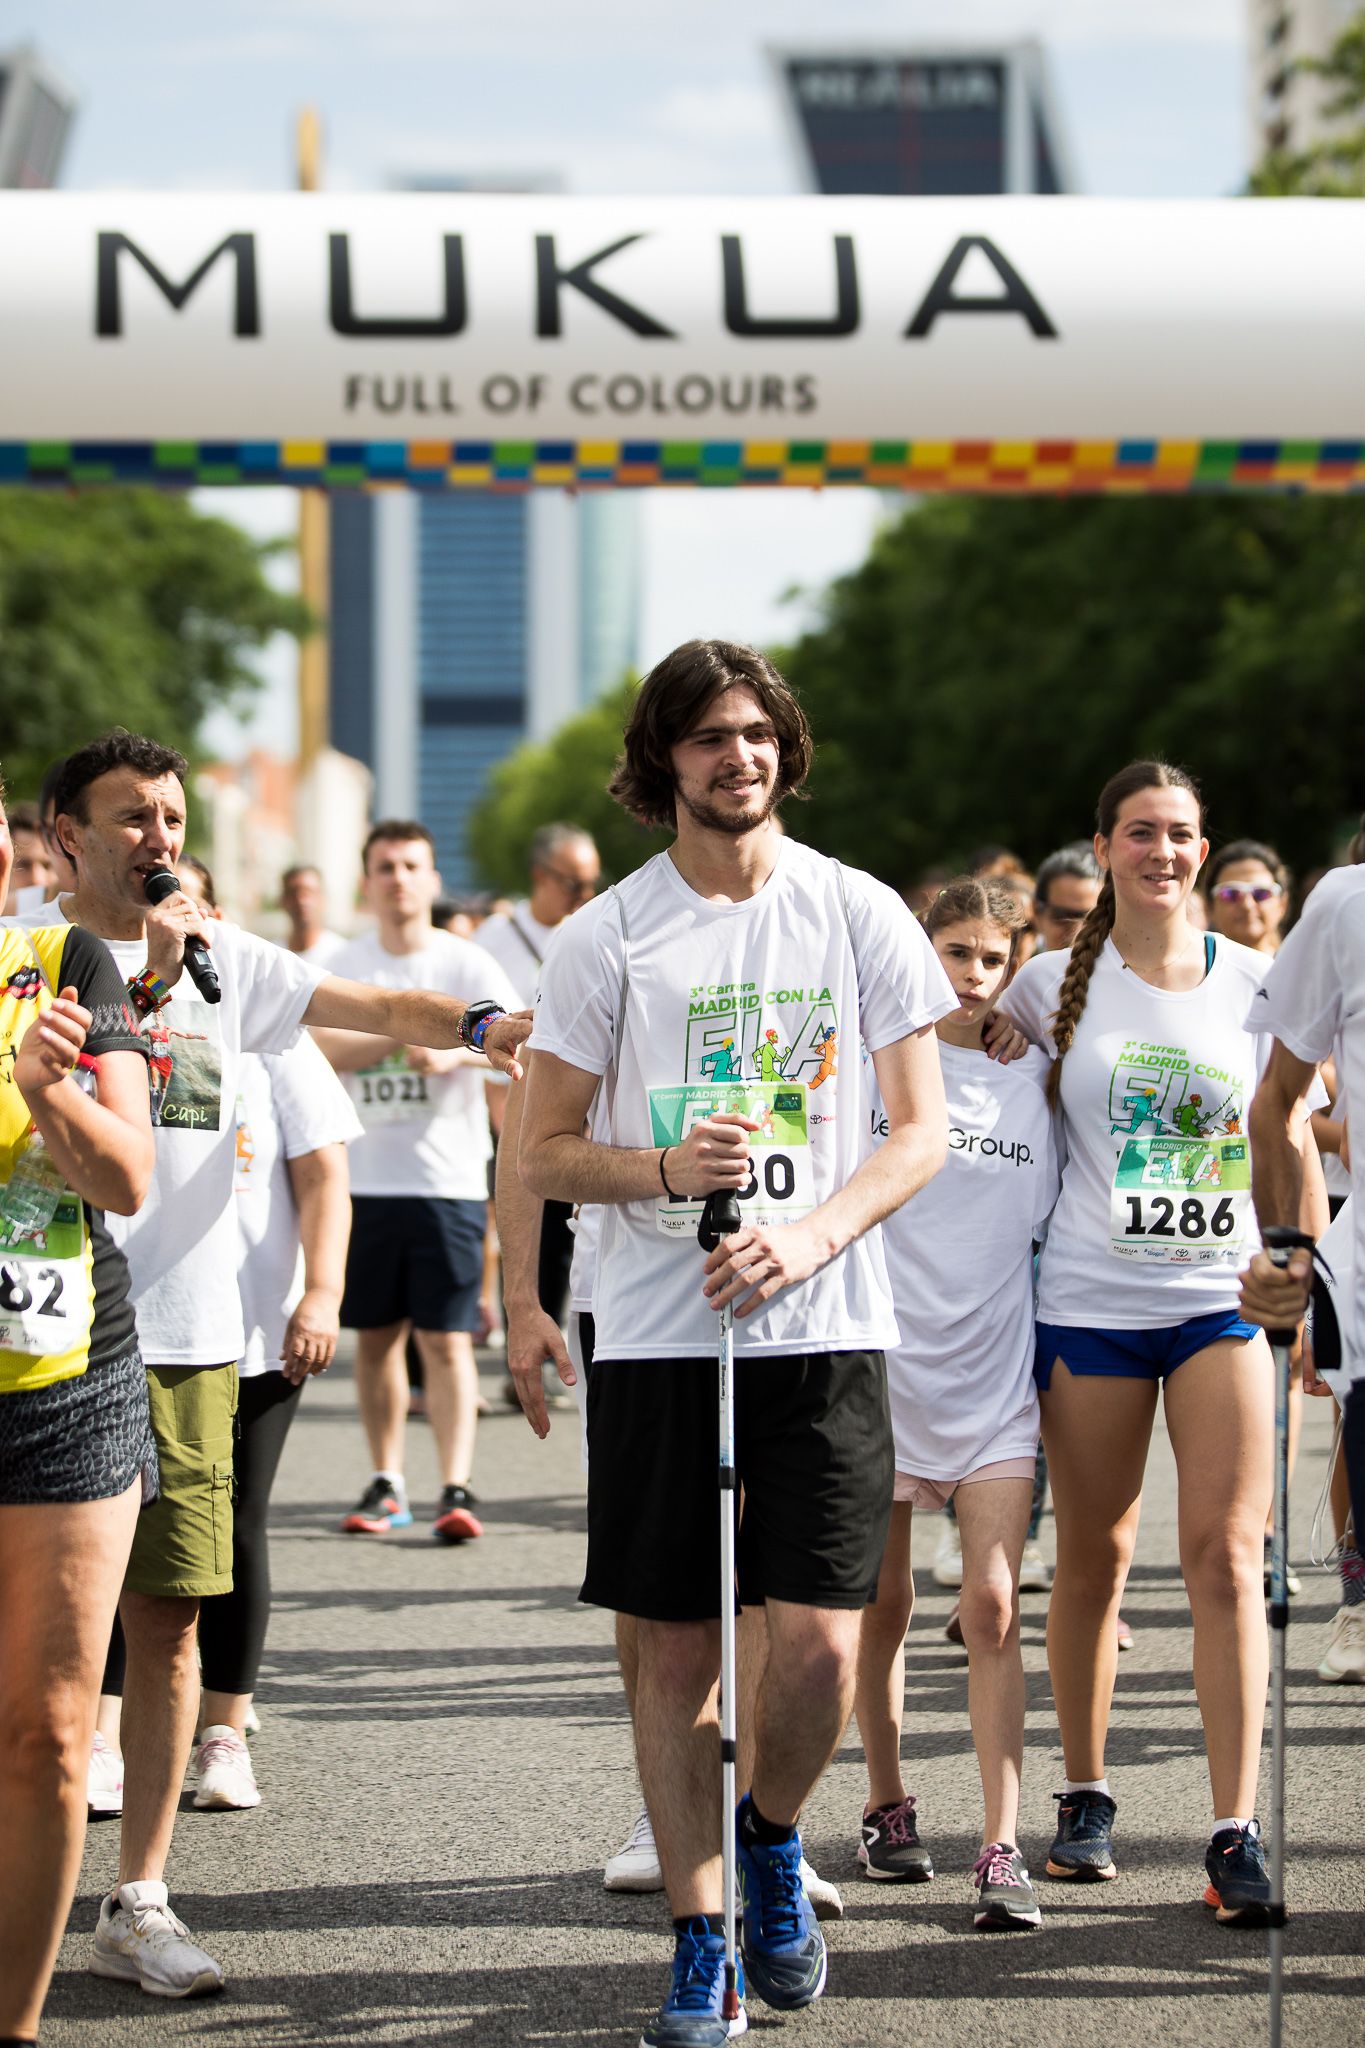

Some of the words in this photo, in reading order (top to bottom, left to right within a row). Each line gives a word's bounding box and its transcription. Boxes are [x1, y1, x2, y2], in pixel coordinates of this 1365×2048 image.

[94, 232, 1060, 338] MUKUA
[344, 373, 461, 415] FULL
[481, 373, 545, 415] OF
[569, 374, 818, 416] COLOURS
[688, 993, 761, 1016] MADRID
[765, 988, 803, 1005] CON
[809, 987, 832, 1001] LA
[707, 982, 756, 996] Carrera
[1139, 1042, 1187, 1056] Carrera
[1118, 1052, 1190, 1071] MADRID
[1194, 1063, 1230, 1083] CON
[362, 1076, 428, 1104] 1021
[686, 1090, 728, 1100] MADRID
[164, 1104, 209, 1129] Capi
[949, 1127, 1034, 1166] Group.
[1151, 1142, 1182, 1151] MADRID
[1141, 1150, 1222, 1187] ELA
[1125, 1196, 1235, 1238] 1286
